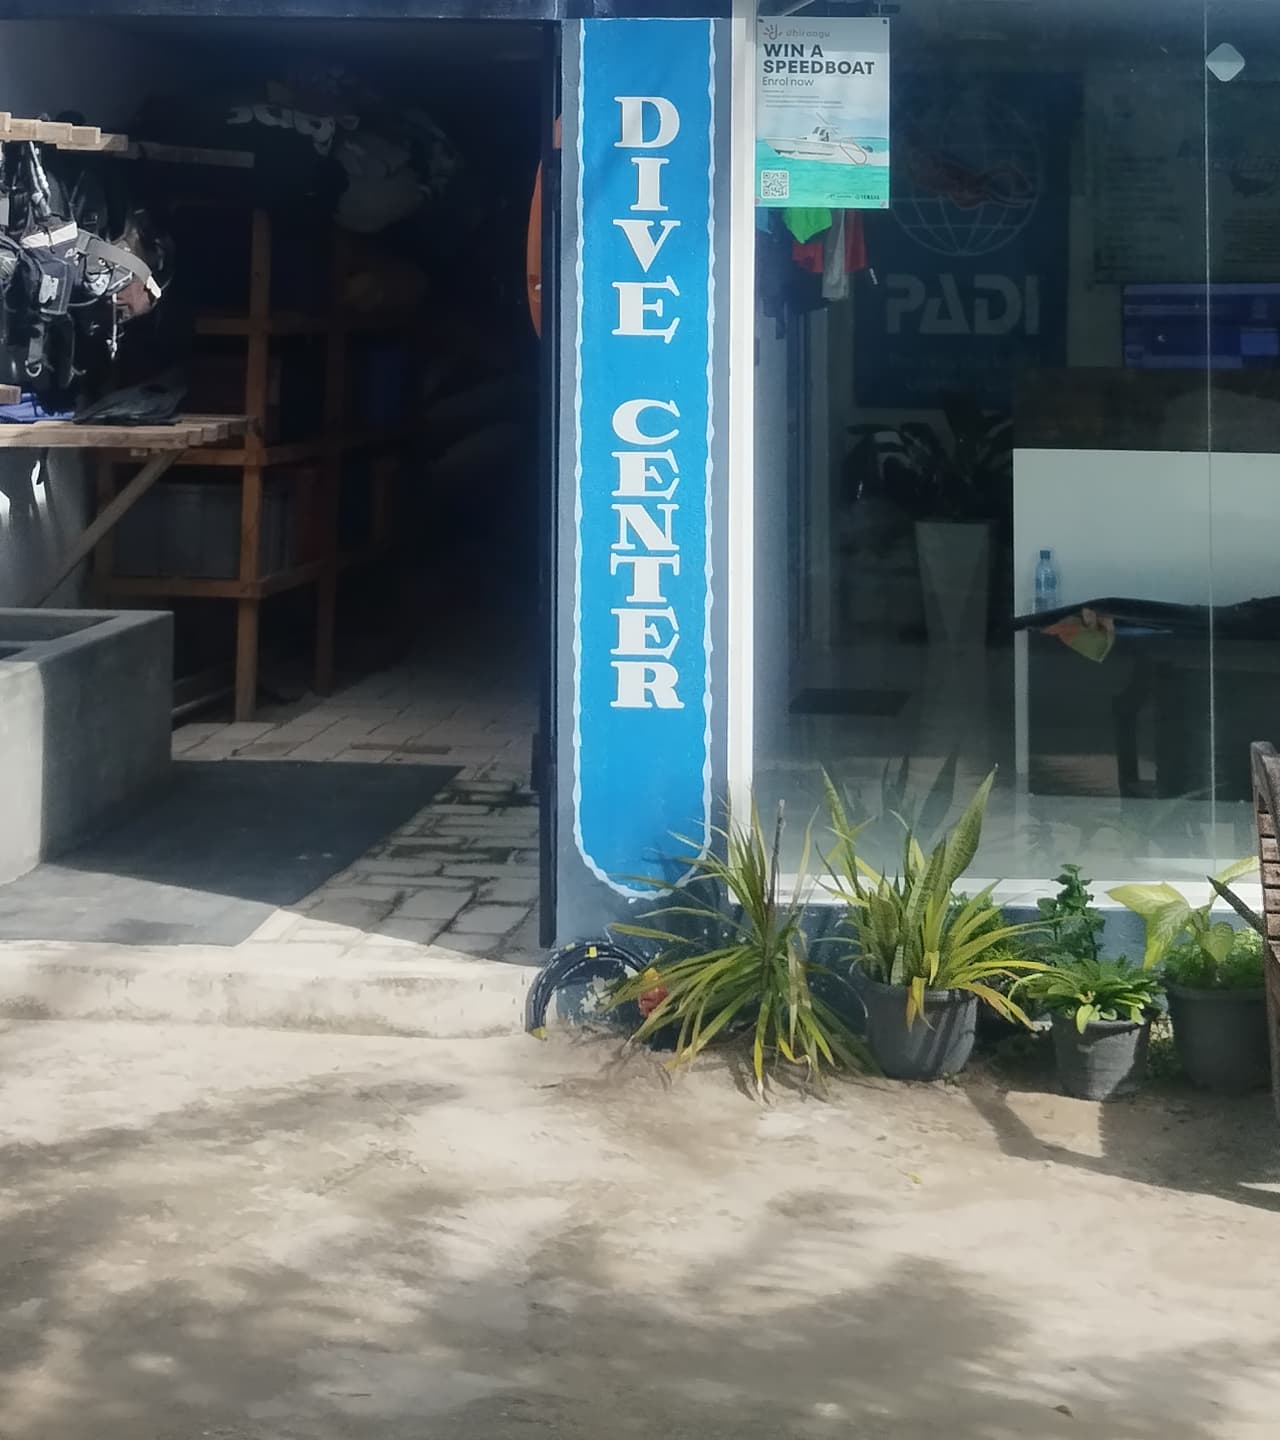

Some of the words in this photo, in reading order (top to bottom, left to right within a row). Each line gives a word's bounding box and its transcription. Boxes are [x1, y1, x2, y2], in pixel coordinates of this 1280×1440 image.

[763, 43, 805, 58] WIN
[810, 44, 824, 58] A
[763, 60, 875, 75] SPEEDBOAT
[762, 77, 788, 87] Enrol
[790, 78, 814, 87] now
[612, 96, 681, 345] DIVE
[884, 274, 1041, 336] PADI
[610, 398, 685, 710] CENTER
